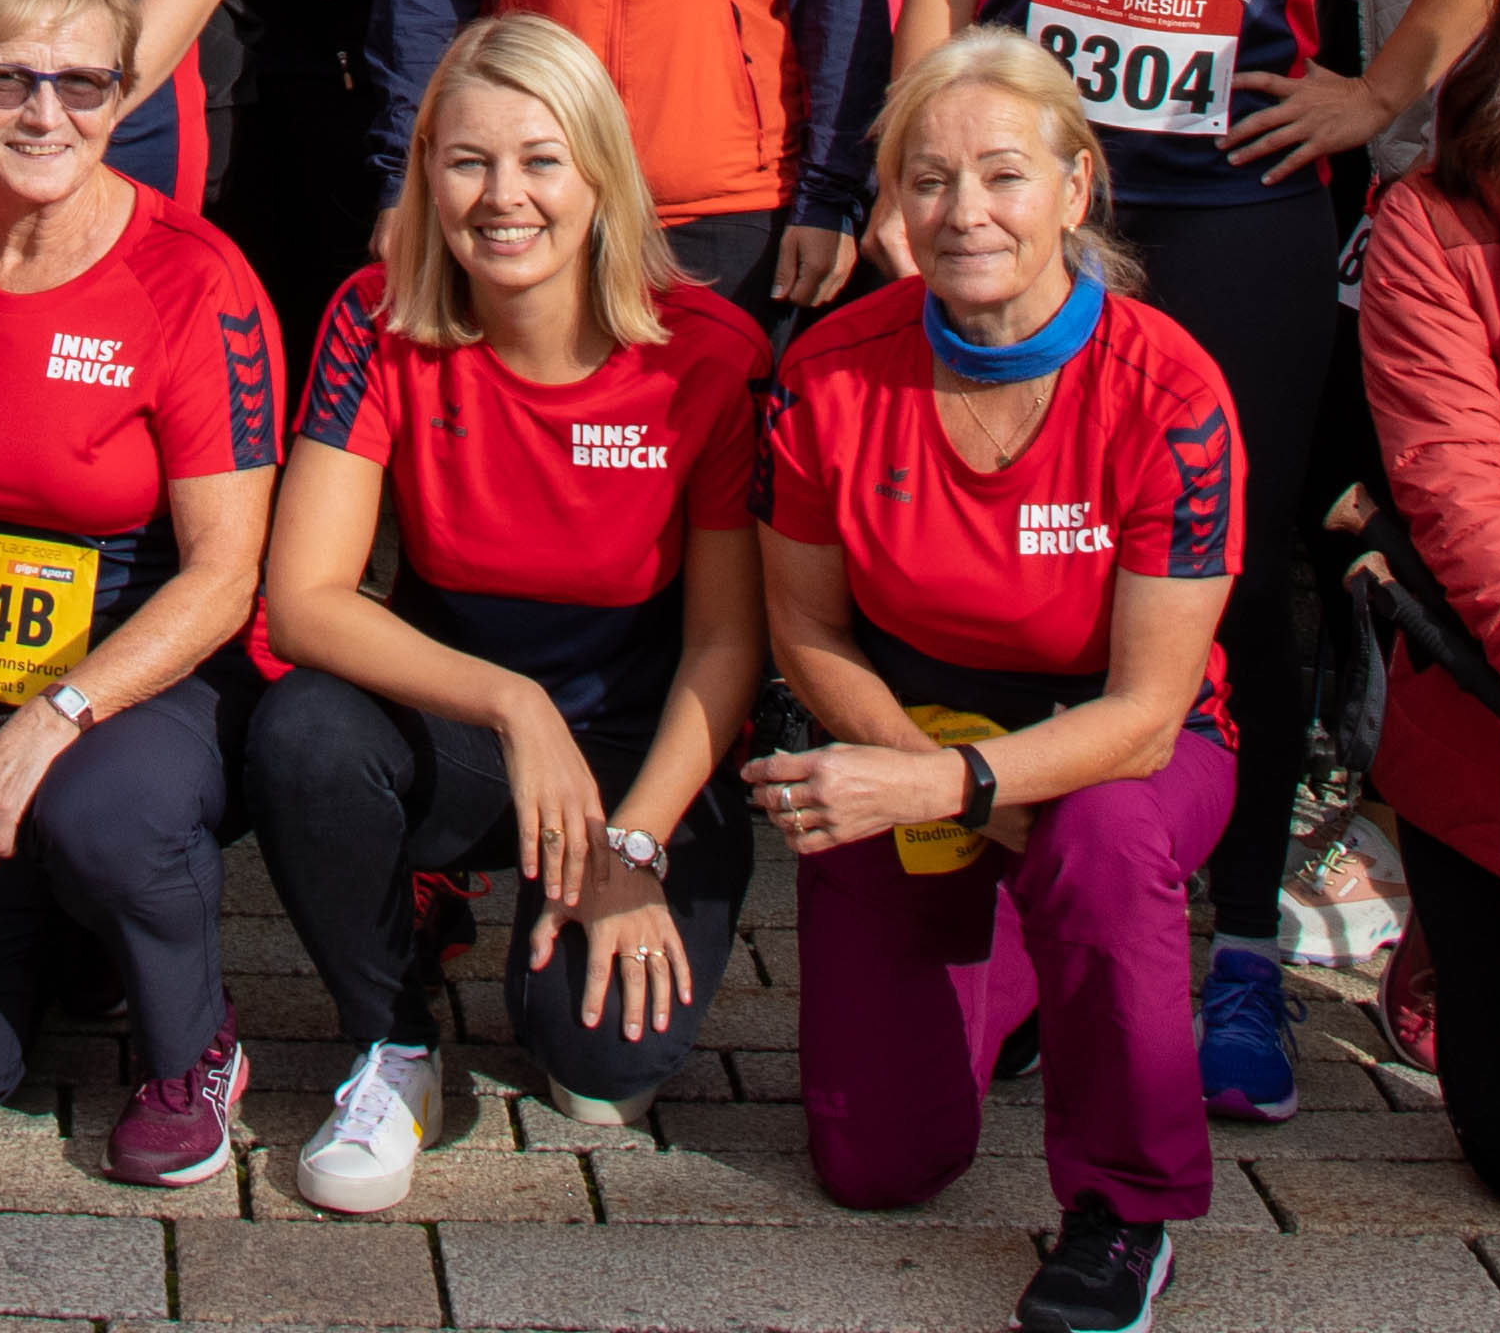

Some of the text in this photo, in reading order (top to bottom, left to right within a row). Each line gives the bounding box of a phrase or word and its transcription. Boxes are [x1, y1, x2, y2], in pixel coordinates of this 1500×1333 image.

[51, 332, 123, 362] INNS'
[46, 356, 135, 388] BRUCK
[571, 423, 649, 447] INNS'
[572, 445, 669, 469] BRUCK
[1019, 501, 1091, 529] INNS'
[1019, 524, 1114, 555] BRUCK
[40, 566, 73, 581] sport
[16, 681, 26, 694] 9
